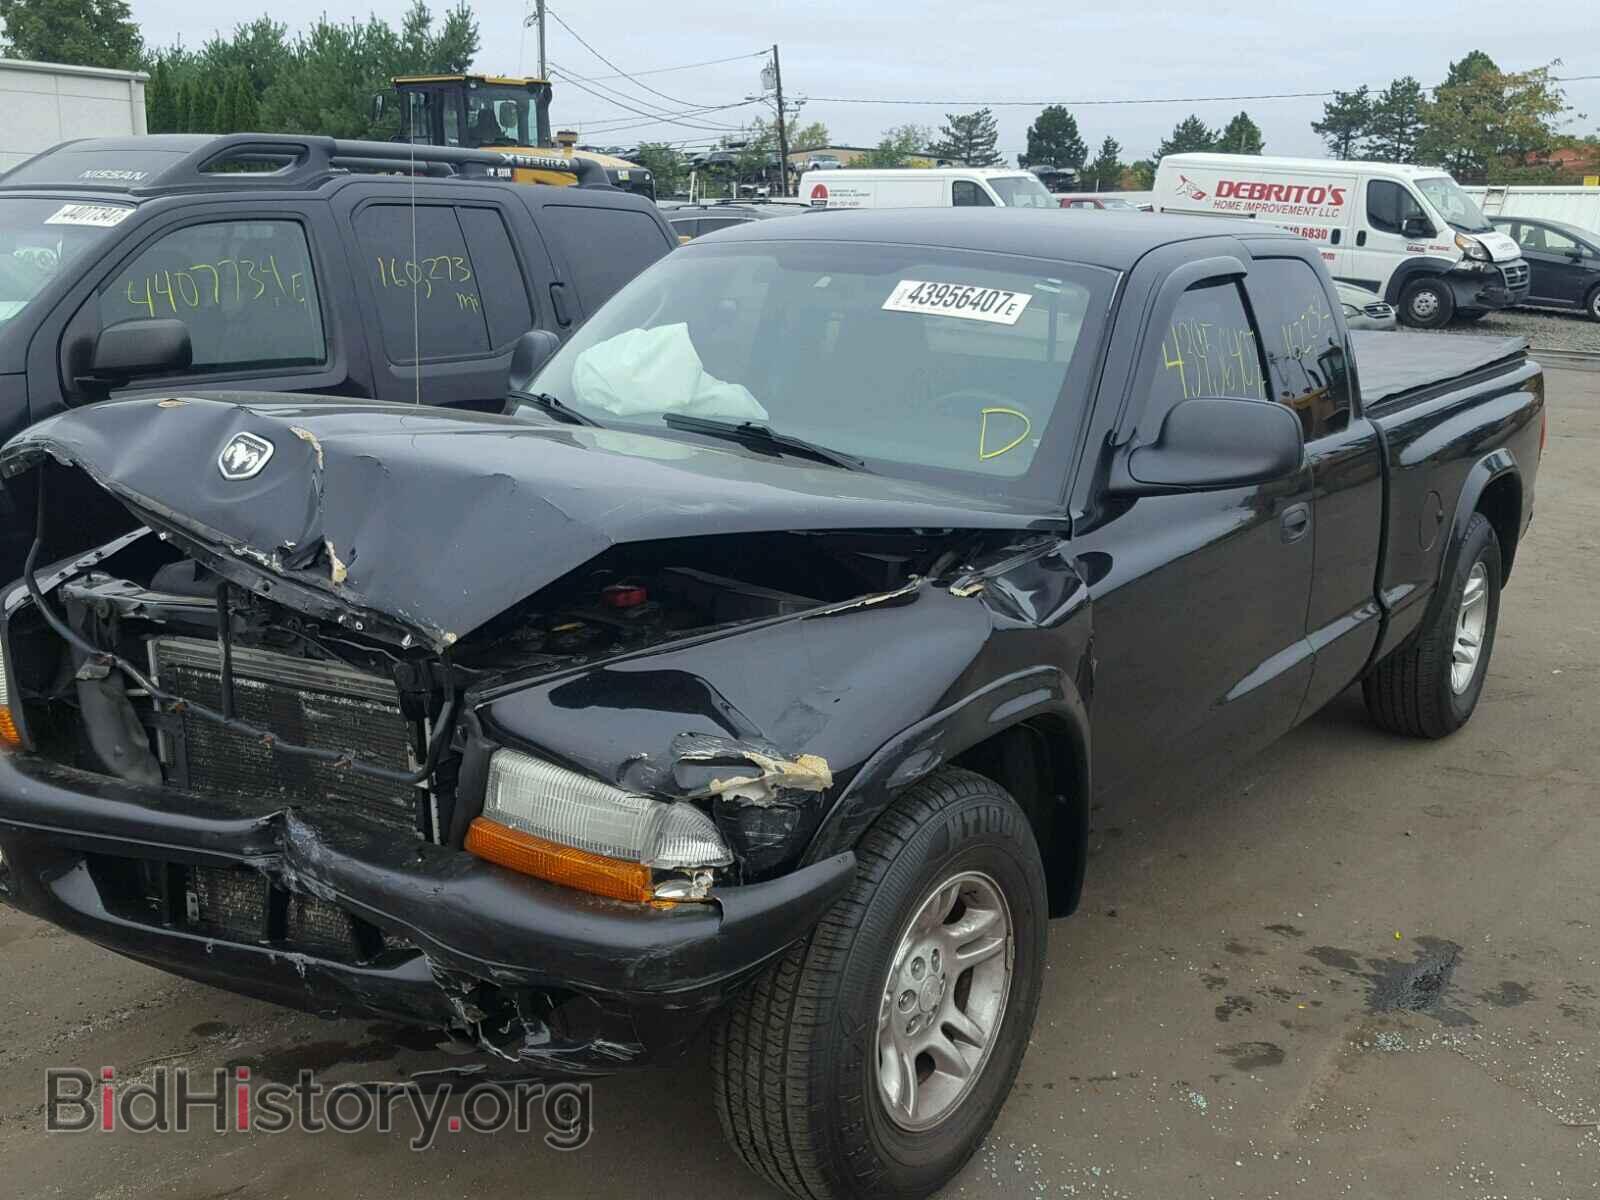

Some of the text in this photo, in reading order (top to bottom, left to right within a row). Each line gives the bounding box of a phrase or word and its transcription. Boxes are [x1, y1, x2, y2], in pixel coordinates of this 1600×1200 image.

[500, 153, 570, 169] XTERRA
[80, 170, 148, 181] NISSAN
[1215, 180, 1346, 206] DEBRITO'S
[1213, 200, 1340, 218] HOME IMPROVEMENT LLC
[1301, 226, 1328, 240] 6830
[377, 256, 471, 298] 160,273
[979, 407, 1031, 462] D
